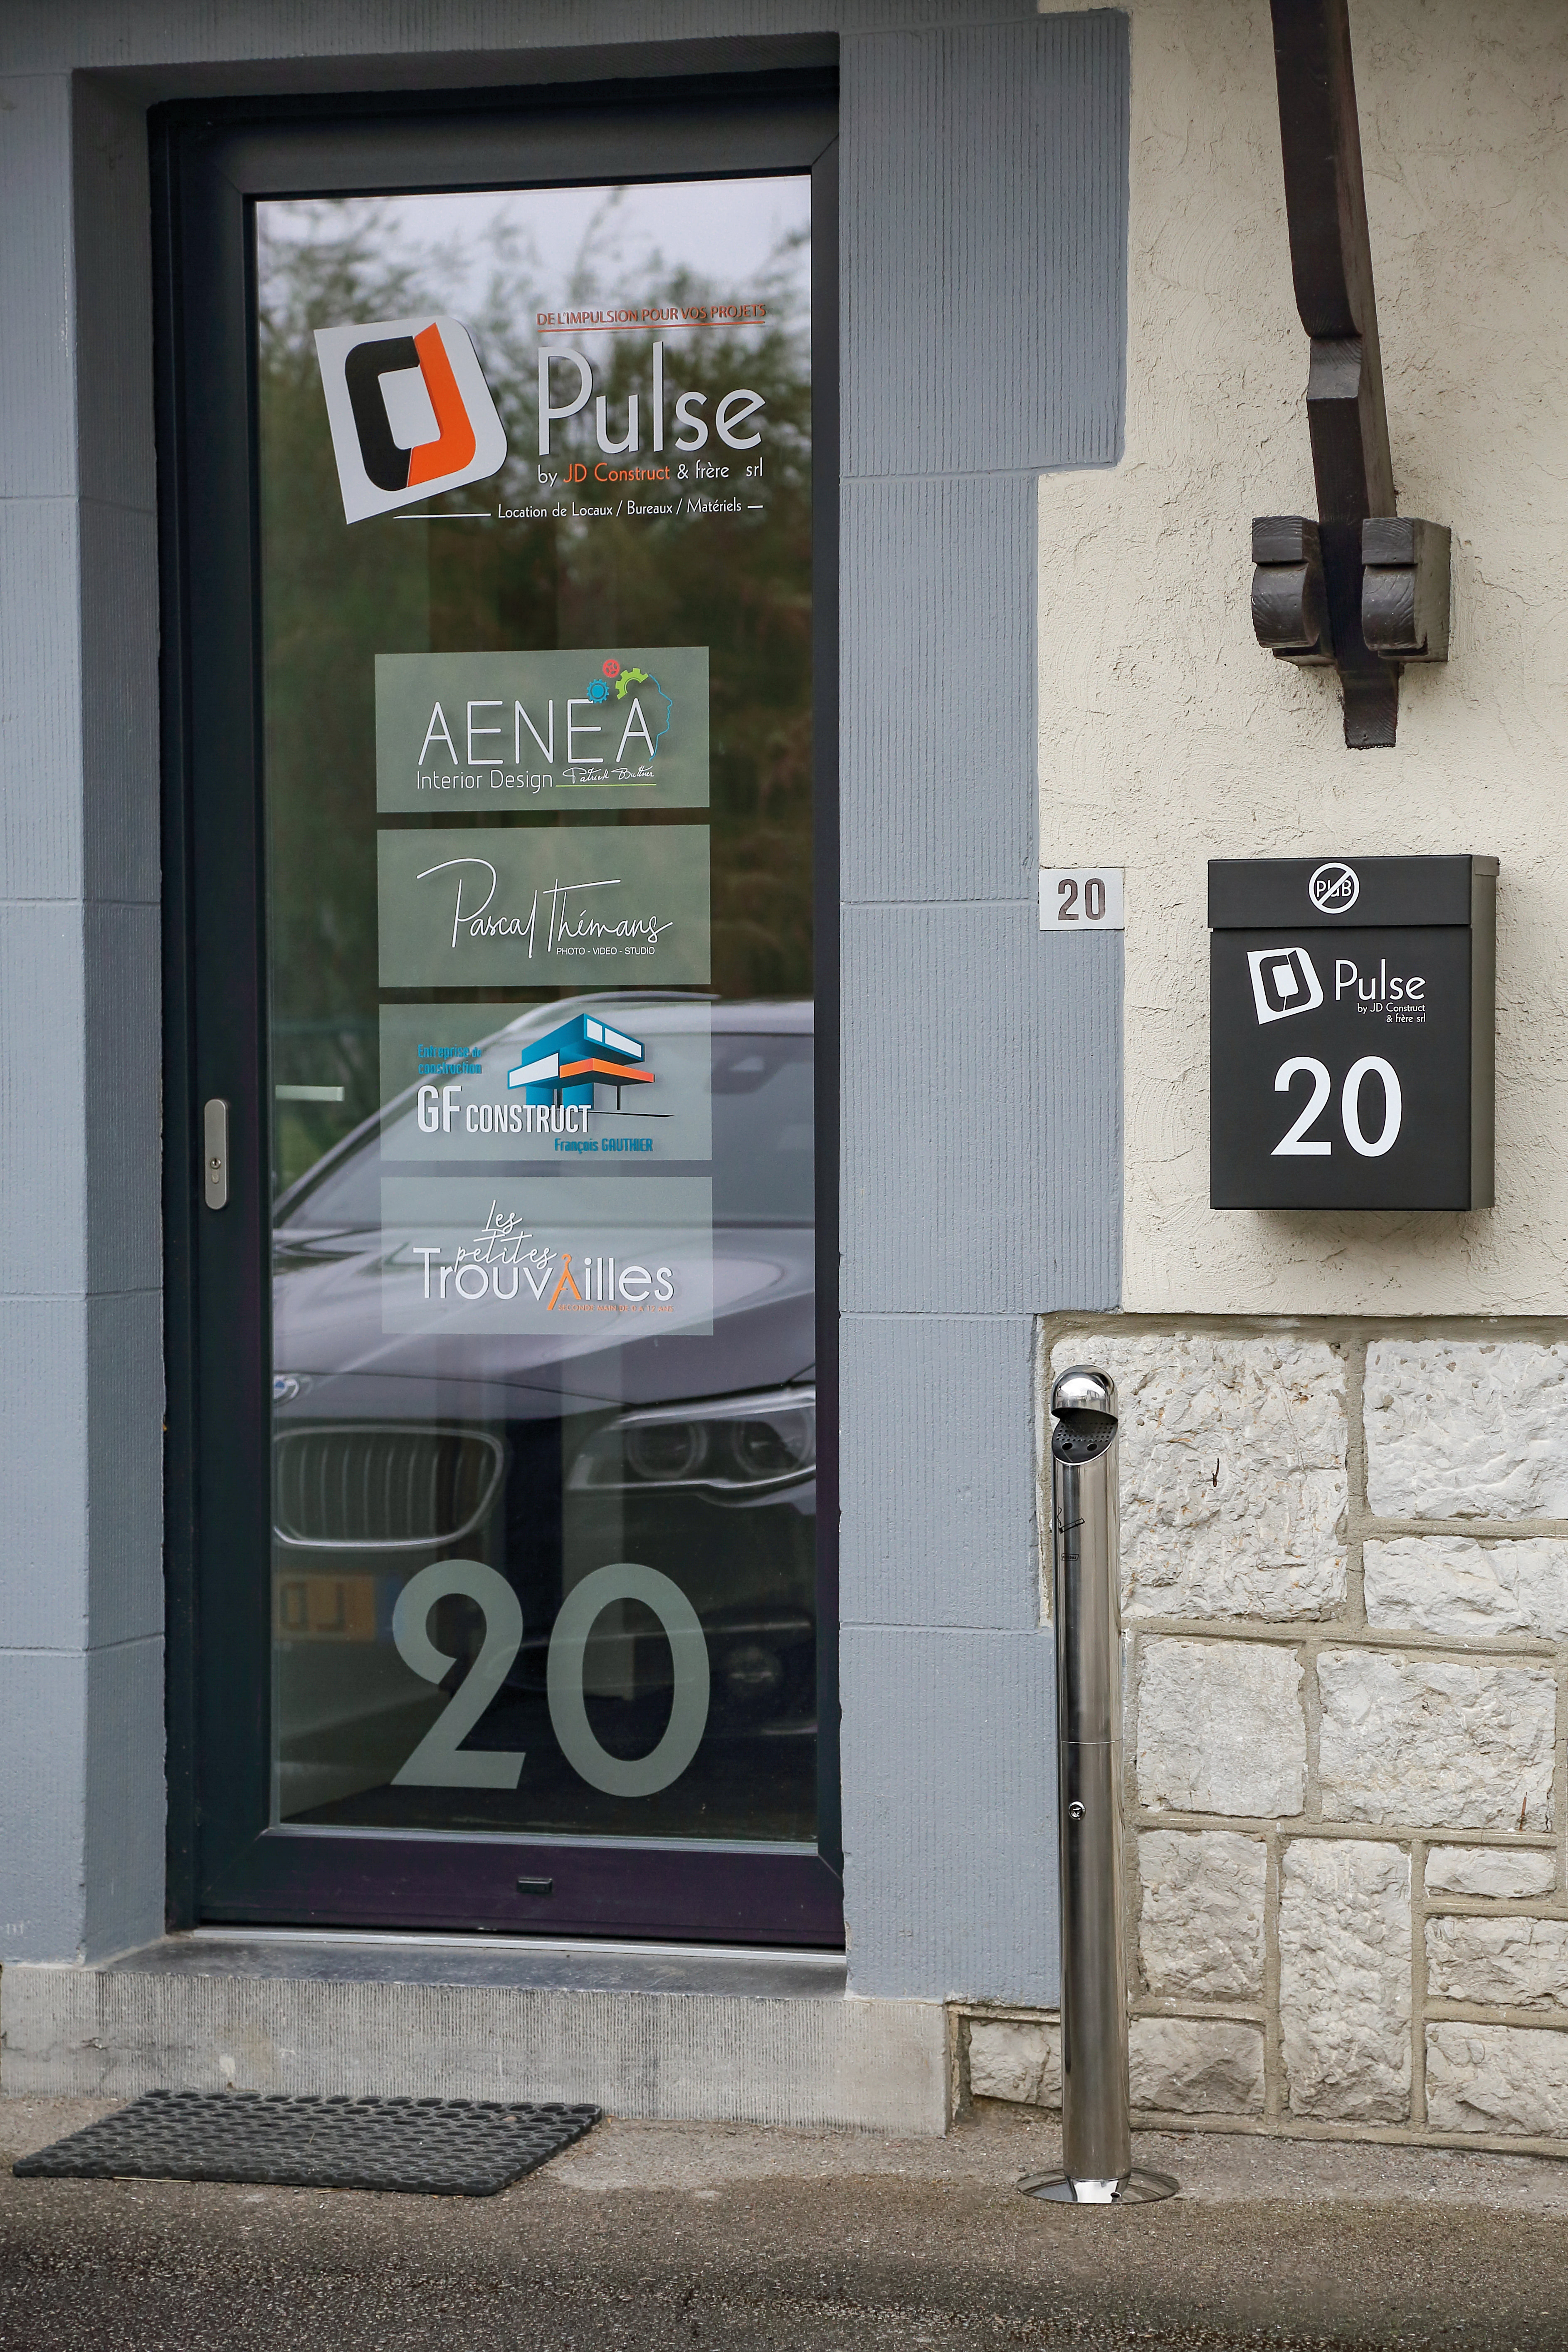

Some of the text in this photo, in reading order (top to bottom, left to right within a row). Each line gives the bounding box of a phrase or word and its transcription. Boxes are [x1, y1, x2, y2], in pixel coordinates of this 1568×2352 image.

[537, 304, 765, 325] DE L'IMPULSION POUR VOS PROJETS
[538, 341, 766, 456] Pulse
[538, 457, 763, 487] by JD Construct & frère srl
[499, 497, 741, 518] Location de Locaux / Bureaux / Matériels
[418, 698, 654, 765] AENEA
[417, 770, 483, 789] Interior
[491, 769, 553, 794] Design
[562, 767, 609, 784] Patrick
[417, 857, 673, 959] Pascal Thémans
[1058, 878, 1106, 921] 20
[625, 947, 655, 955] STUDIO
[1336, 958, 1426, 1000] Pulse
[1357, 1002, 1425, 1014] by JD Construct
[1395, 1013, 1413, 1022] frère
[1417, 1013, 1425, 1022] srl
[417, 1044, 482, 1060] Entreprise de
[418, 1061, 482, 1074] construction
[417, 1085, 591, 1133] GF CONSTRUCT
[1270, 1056, 1403, 1157] 20
[555, 1138, 653, 1154] François GAUTHIER
[482, 1199, 523, 1234] Les
[454, 1231, 557, 1272] petites
[390, 1559, 711, 1797] 20
